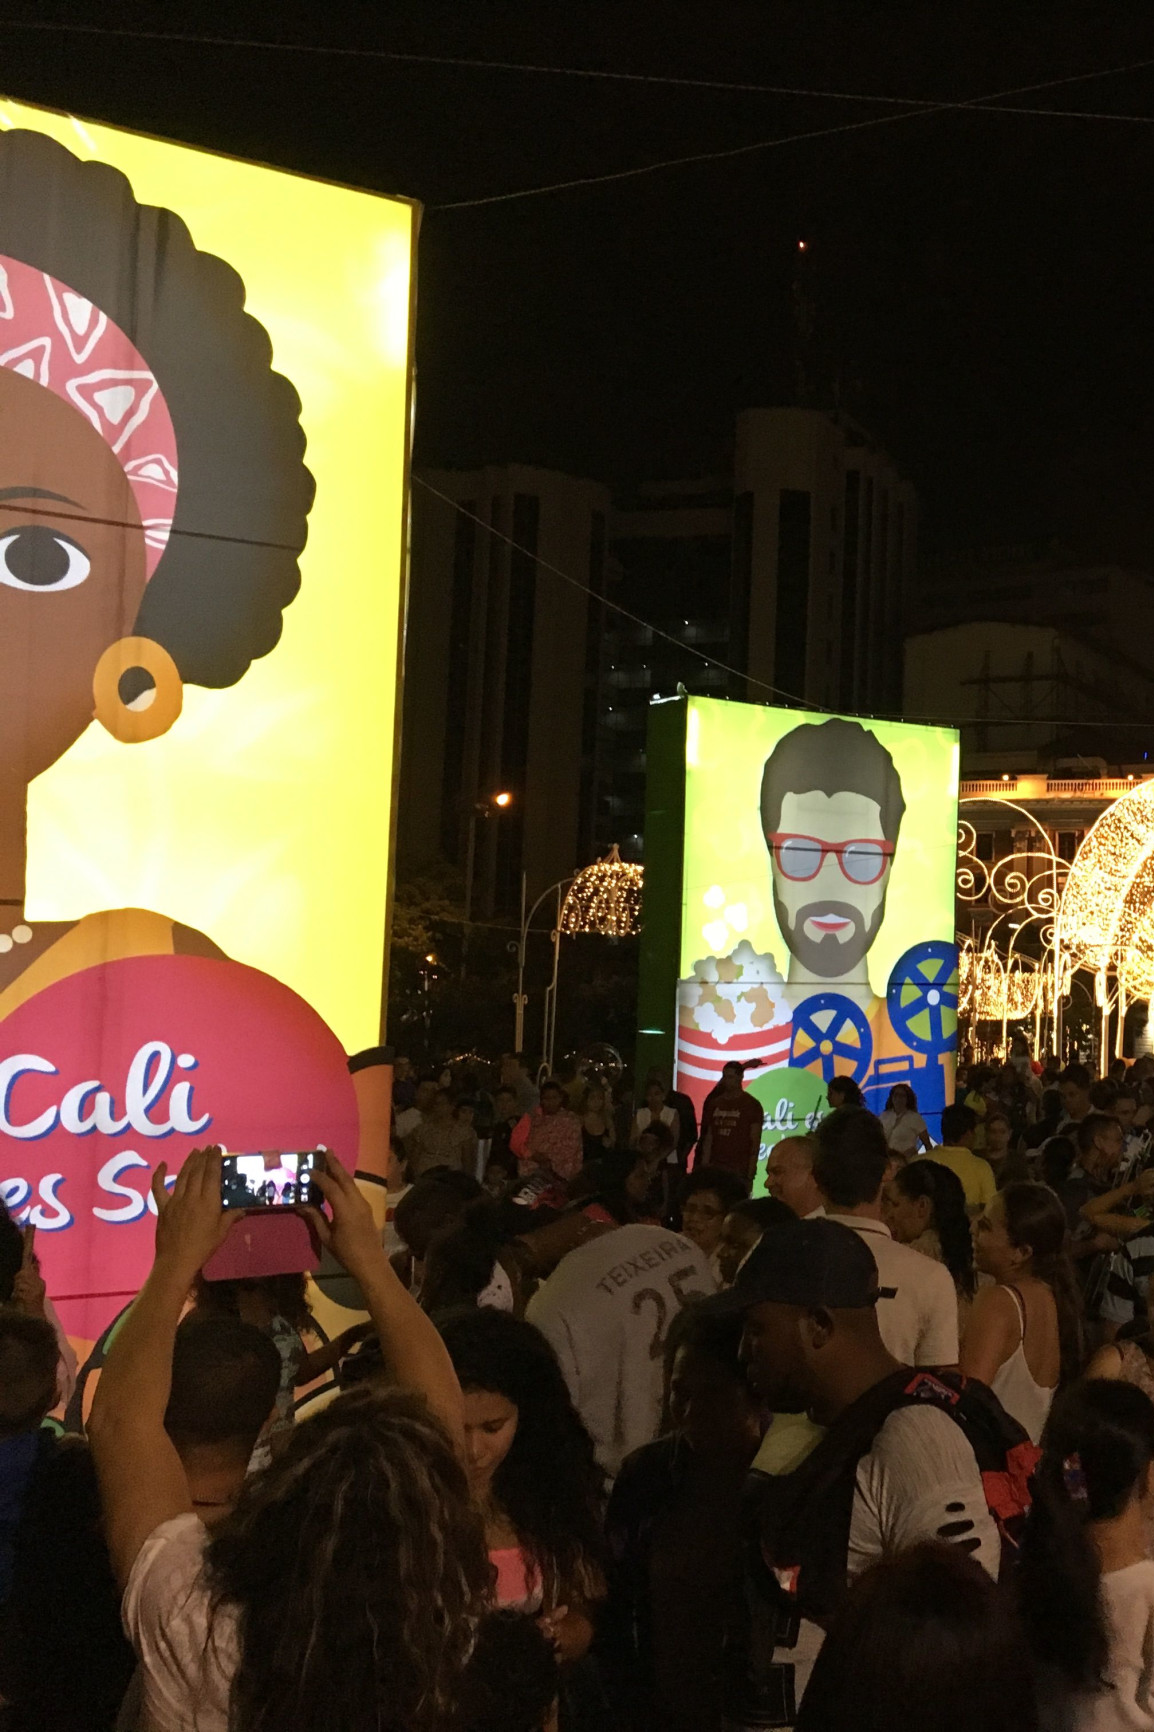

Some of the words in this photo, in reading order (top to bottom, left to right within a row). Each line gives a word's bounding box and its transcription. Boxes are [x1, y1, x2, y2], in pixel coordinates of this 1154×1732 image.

[0, 1041, 213, 1141] Cali
[762, 1097, 798, 1131] ali
[596, 1239, 692, 1296] TEIXEIRA
